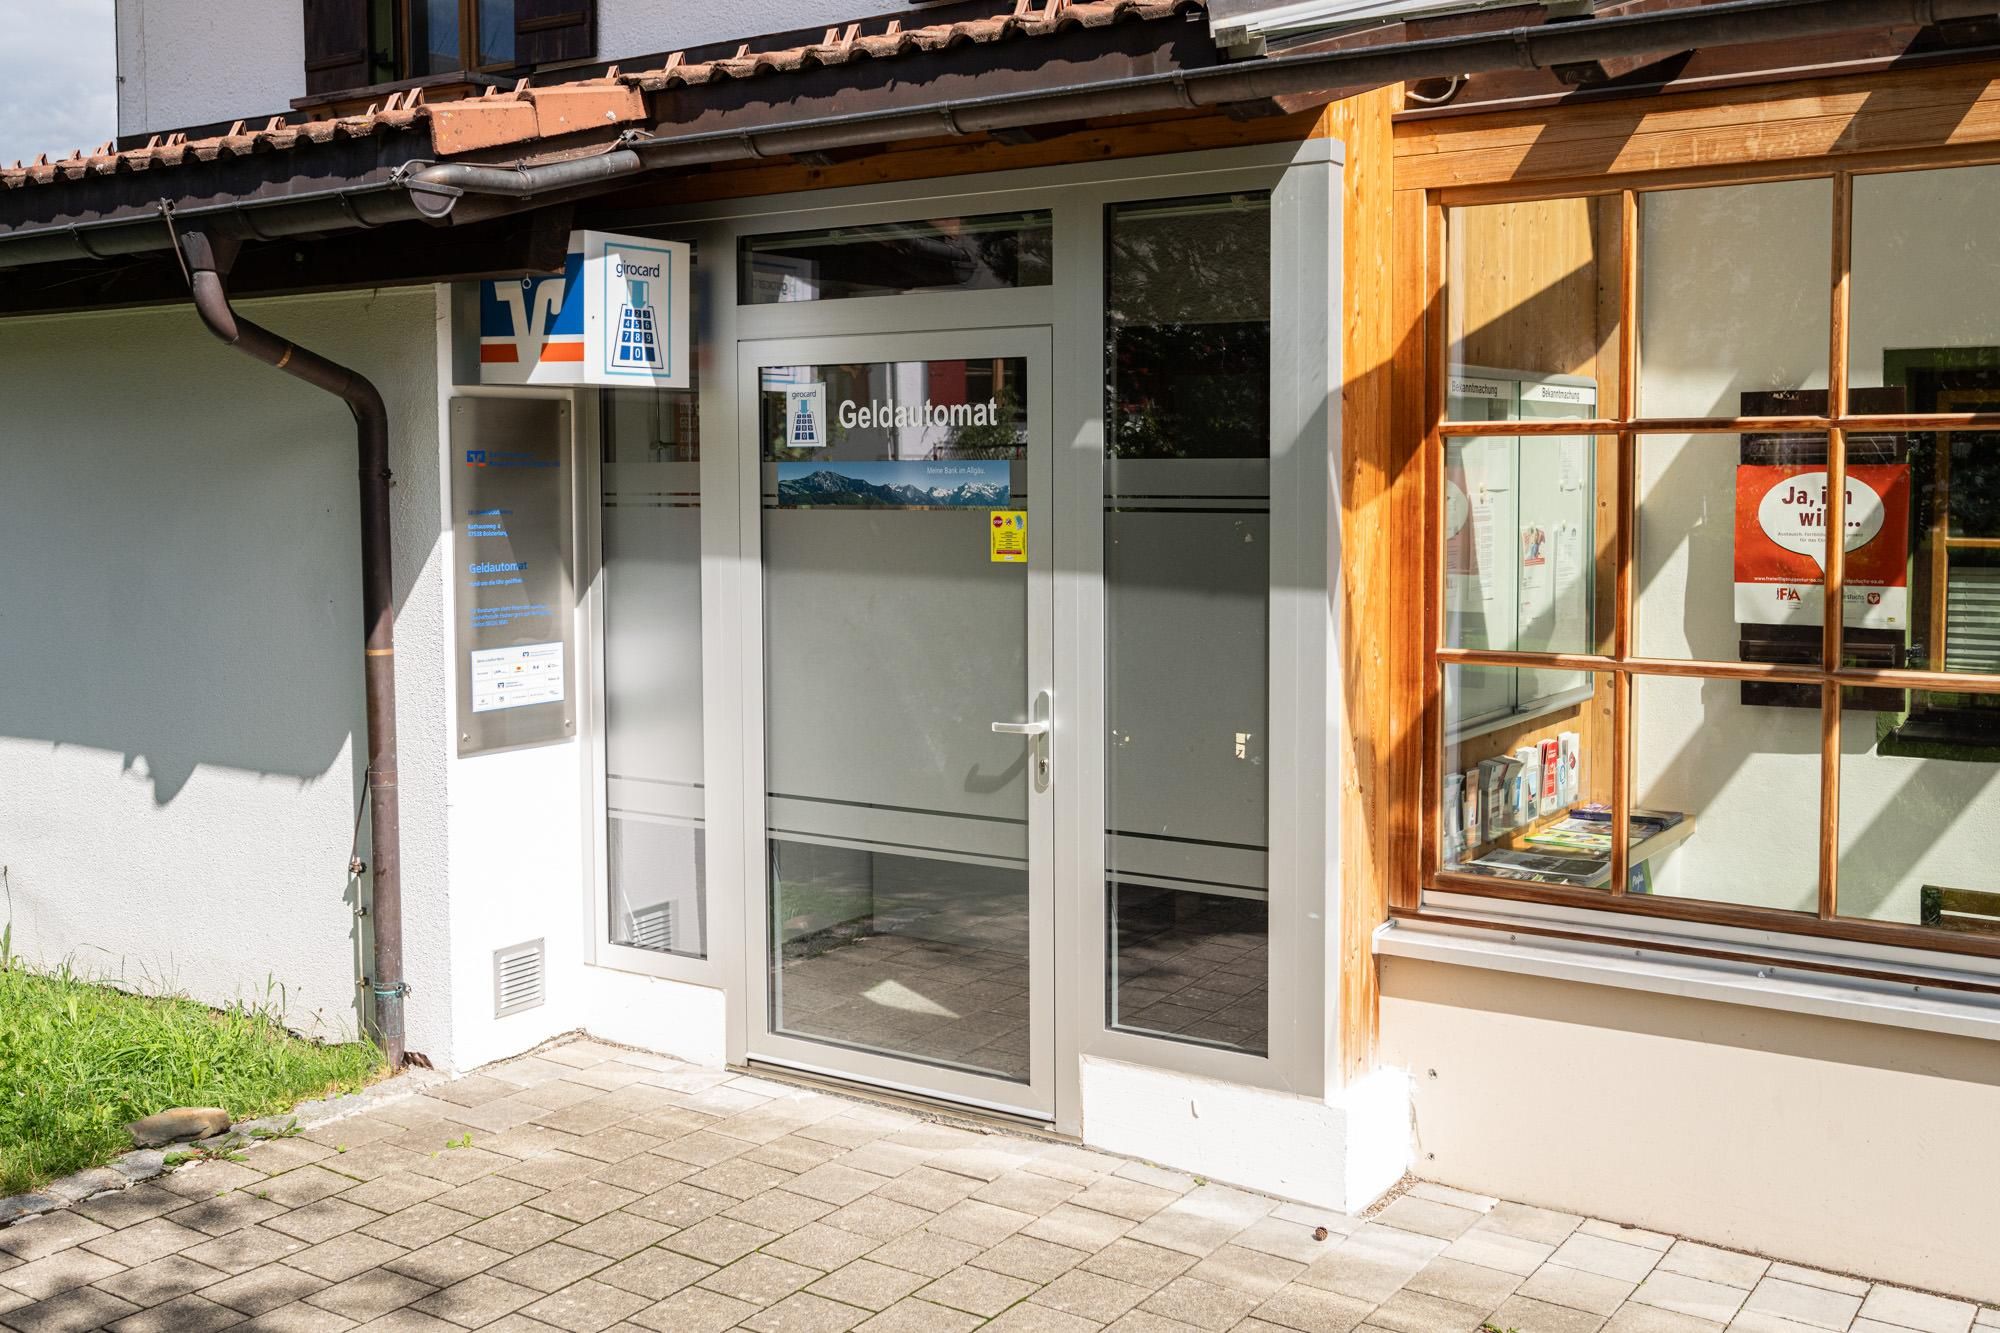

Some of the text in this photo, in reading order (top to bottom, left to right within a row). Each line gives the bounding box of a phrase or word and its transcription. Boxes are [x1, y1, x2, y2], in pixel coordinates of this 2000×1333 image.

[616, 260, 660, 278] girocard
[634, 348, 641, 359] 0
[791, 389, 817, 400] girocard
[1451, 381, 1498, 397] Bekanntmachung
[1541, 387, 1580, 403] Bekanntmachung
[839, 396, 998, 429] Geldautomat
[944, 466, 958, 474] Bank
[966, 466, 986, 477] Allgäu.
[1781, 486, 1852, 507] Ja, ih
[468, 561, 528, 574] Geldautomat
